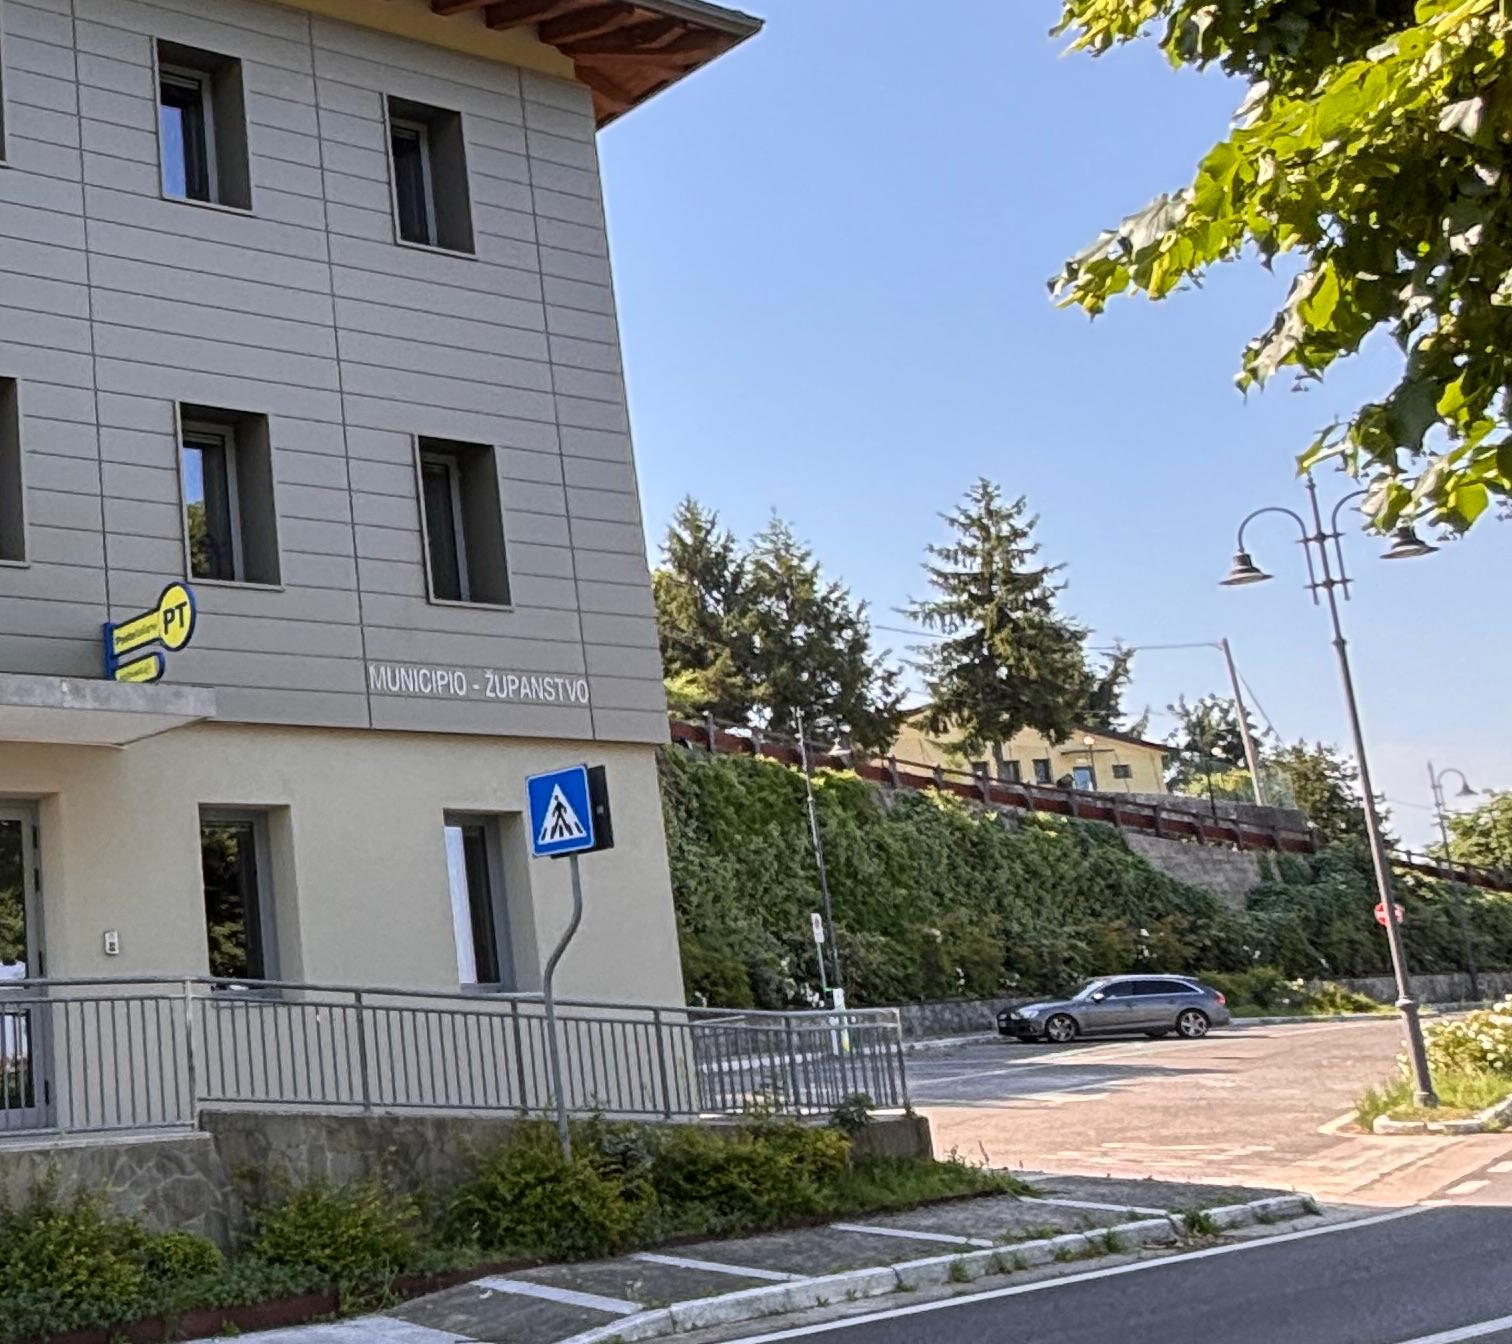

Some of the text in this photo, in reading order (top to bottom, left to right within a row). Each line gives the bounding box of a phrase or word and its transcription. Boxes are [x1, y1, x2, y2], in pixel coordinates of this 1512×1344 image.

[163, 601, 188, 635] PT
[369, 664, 466, 696] MUNICIPIO
[485, 669, 590, 704] ŽUPANSTVO
